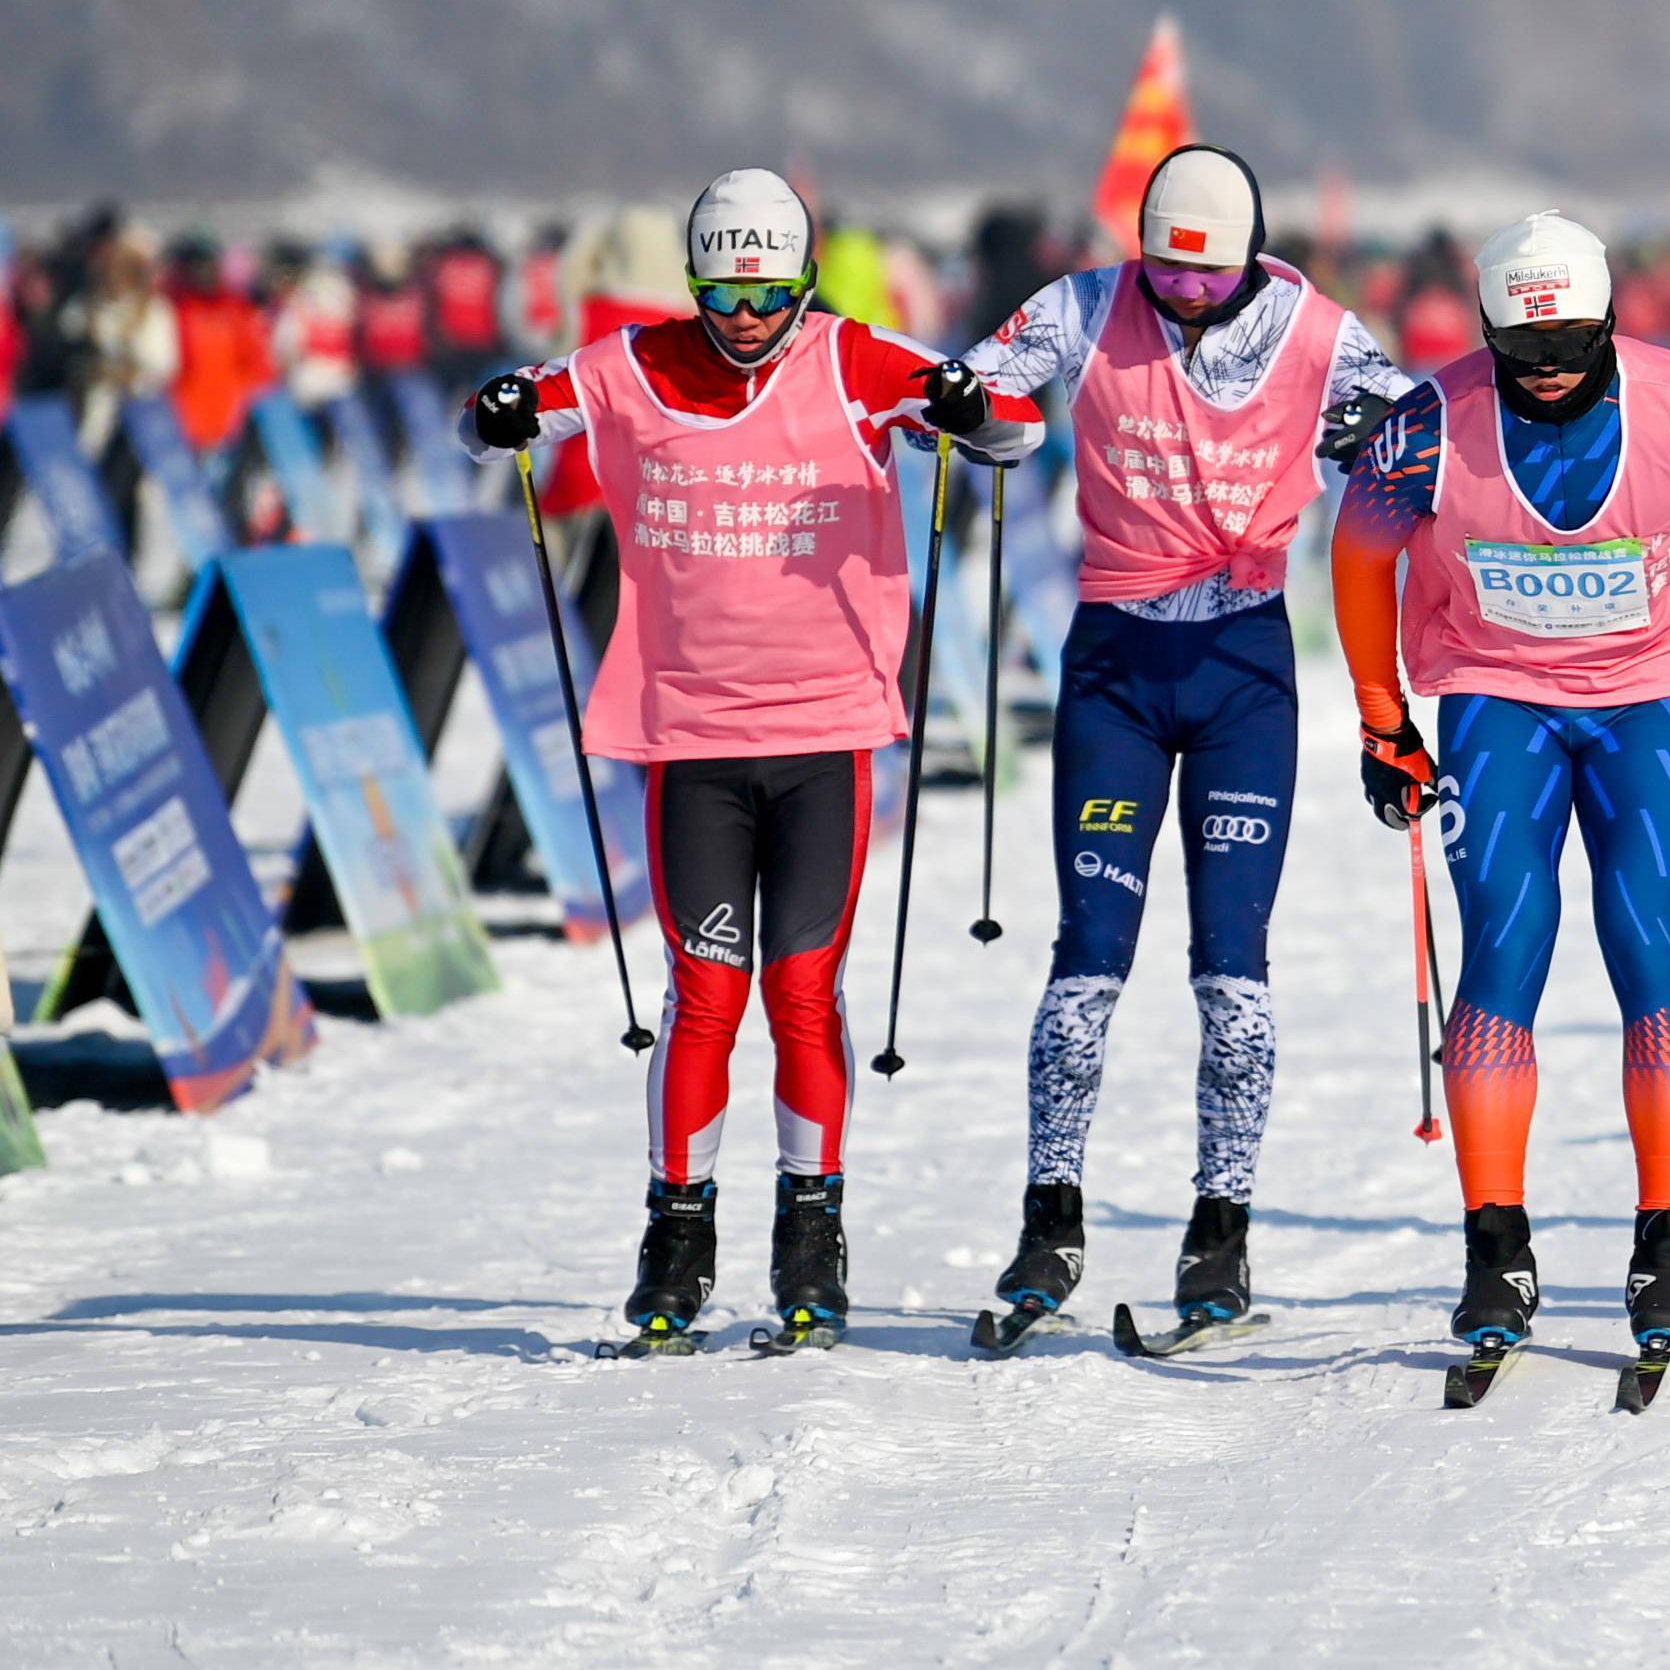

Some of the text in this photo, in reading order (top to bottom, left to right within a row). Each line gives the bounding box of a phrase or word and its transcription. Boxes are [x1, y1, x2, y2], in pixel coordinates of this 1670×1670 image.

[700, 229, 779, 252] VITAL
[714, 460, 820, 489] 逐梦冰雪情
[1480, 568, 1638, 598] B0002
[1080, 799, 1138, 822] FF
[1203, 841, 1230, 853] Audi
